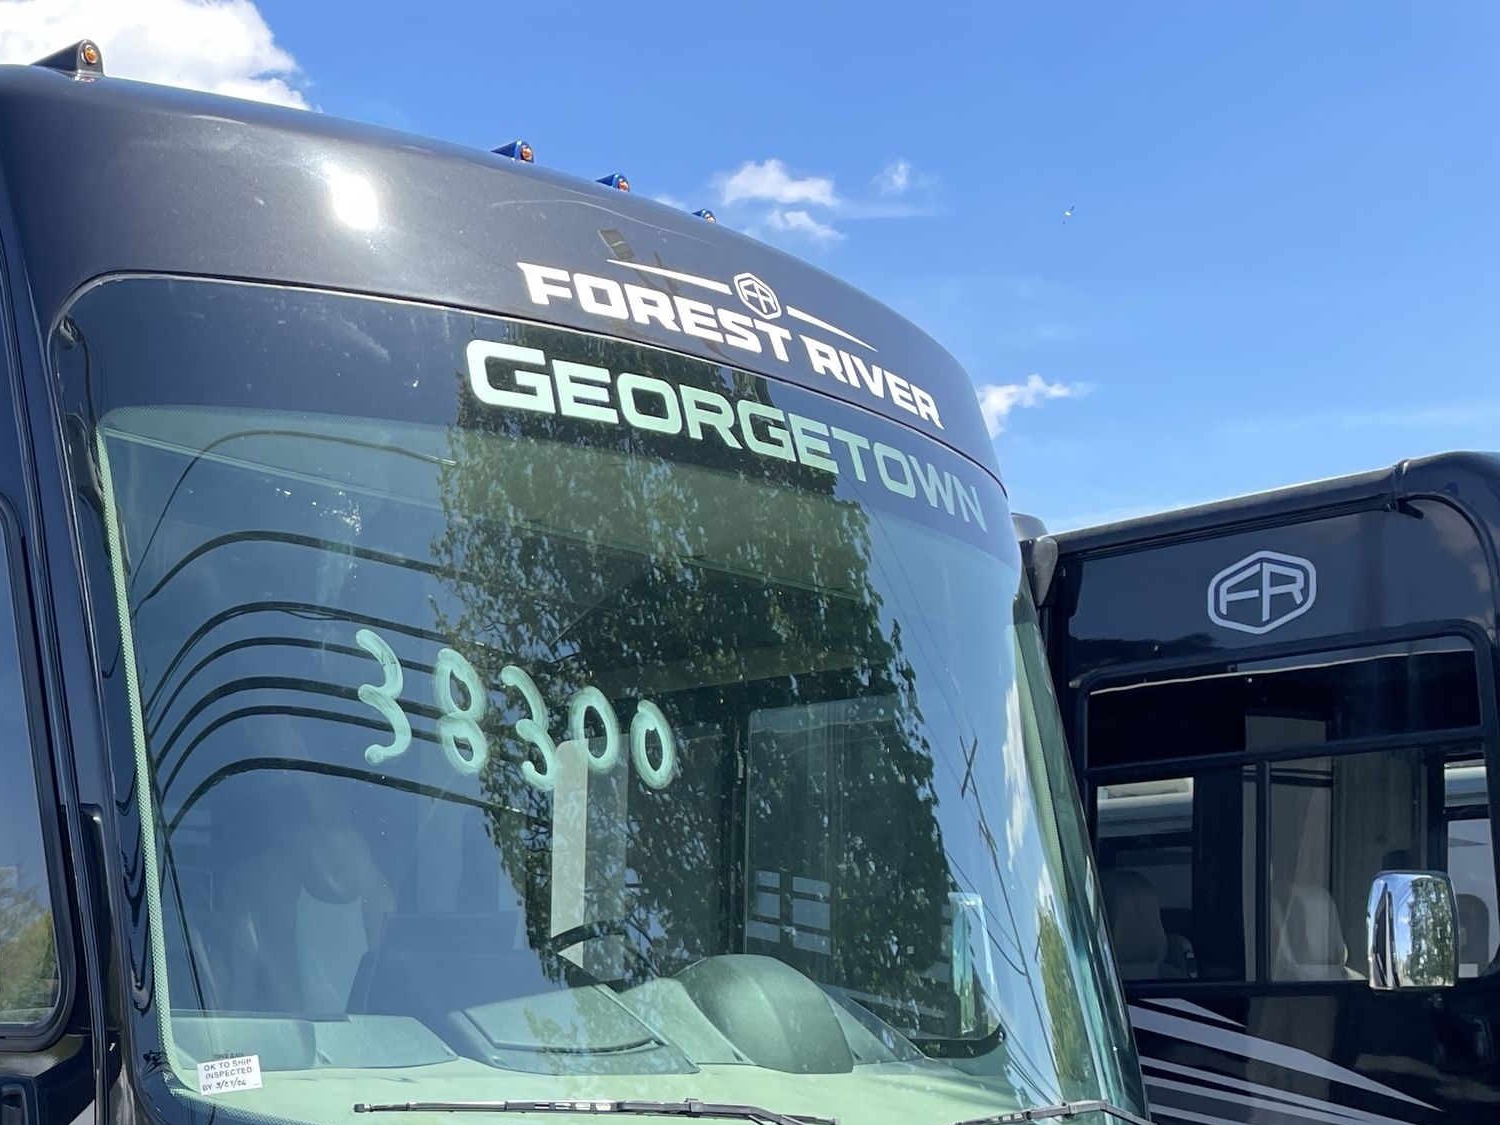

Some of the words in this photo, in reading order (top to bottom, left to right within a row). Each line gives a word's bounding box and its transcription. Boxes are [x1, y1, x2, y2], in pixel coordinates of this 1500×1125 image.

[517, 261, 793, 363] FOREST
[800, 334, 945, 431] RIVER
[465, 339, 988, 534] GEORGETOWN
[355, 628, 677, 792] 38300
[203, 1063, 217, 1072] OK
[219, 1061, 231, 1069] TO
[232, 1058, 252, 1067] SHIP
[205, 1066, 253, 1080] INSPECTED
